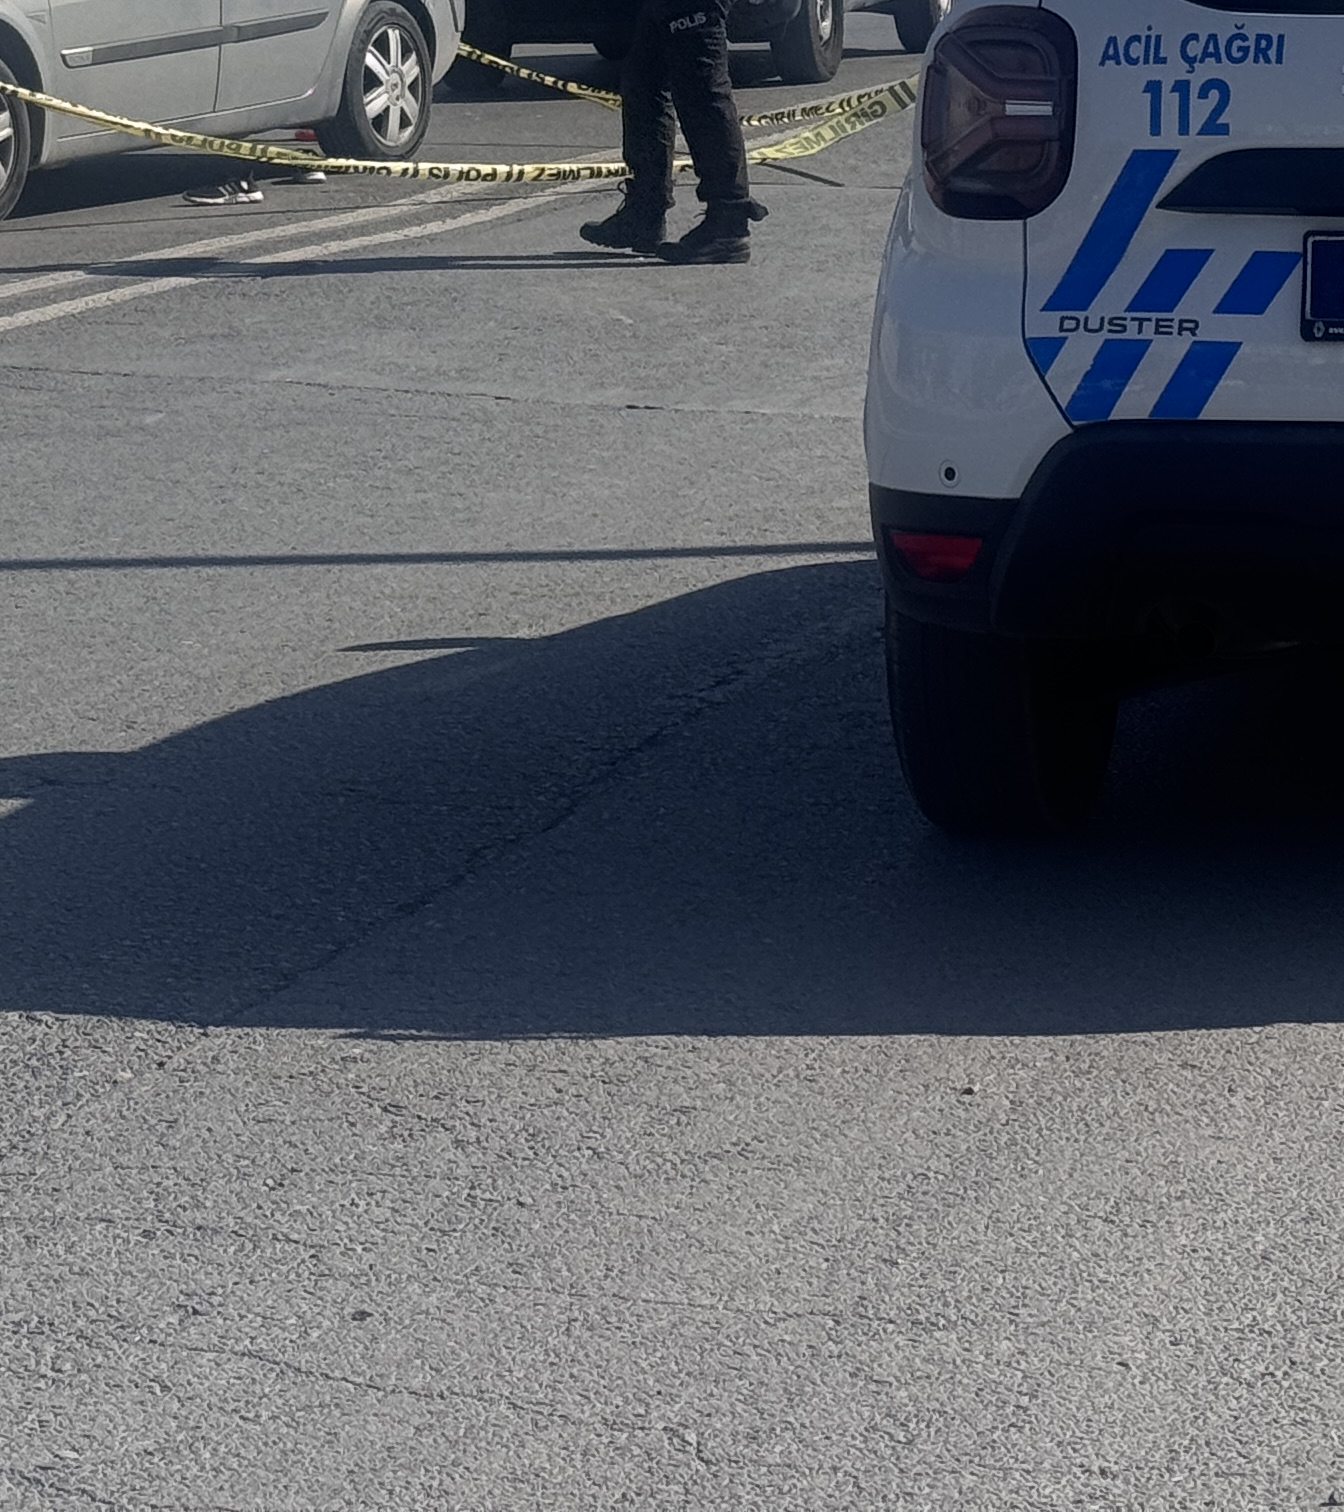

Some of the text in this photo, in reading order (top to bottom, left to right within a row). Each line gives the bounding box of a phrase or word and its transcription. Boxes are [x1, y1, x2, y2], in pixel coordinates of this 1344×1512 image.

[1099, 23, 1286, 74] ACİL ÇAĞRI
[1142, 78, 1232, 137] 112
[1058, 315, 1201, 337] DUSTER
